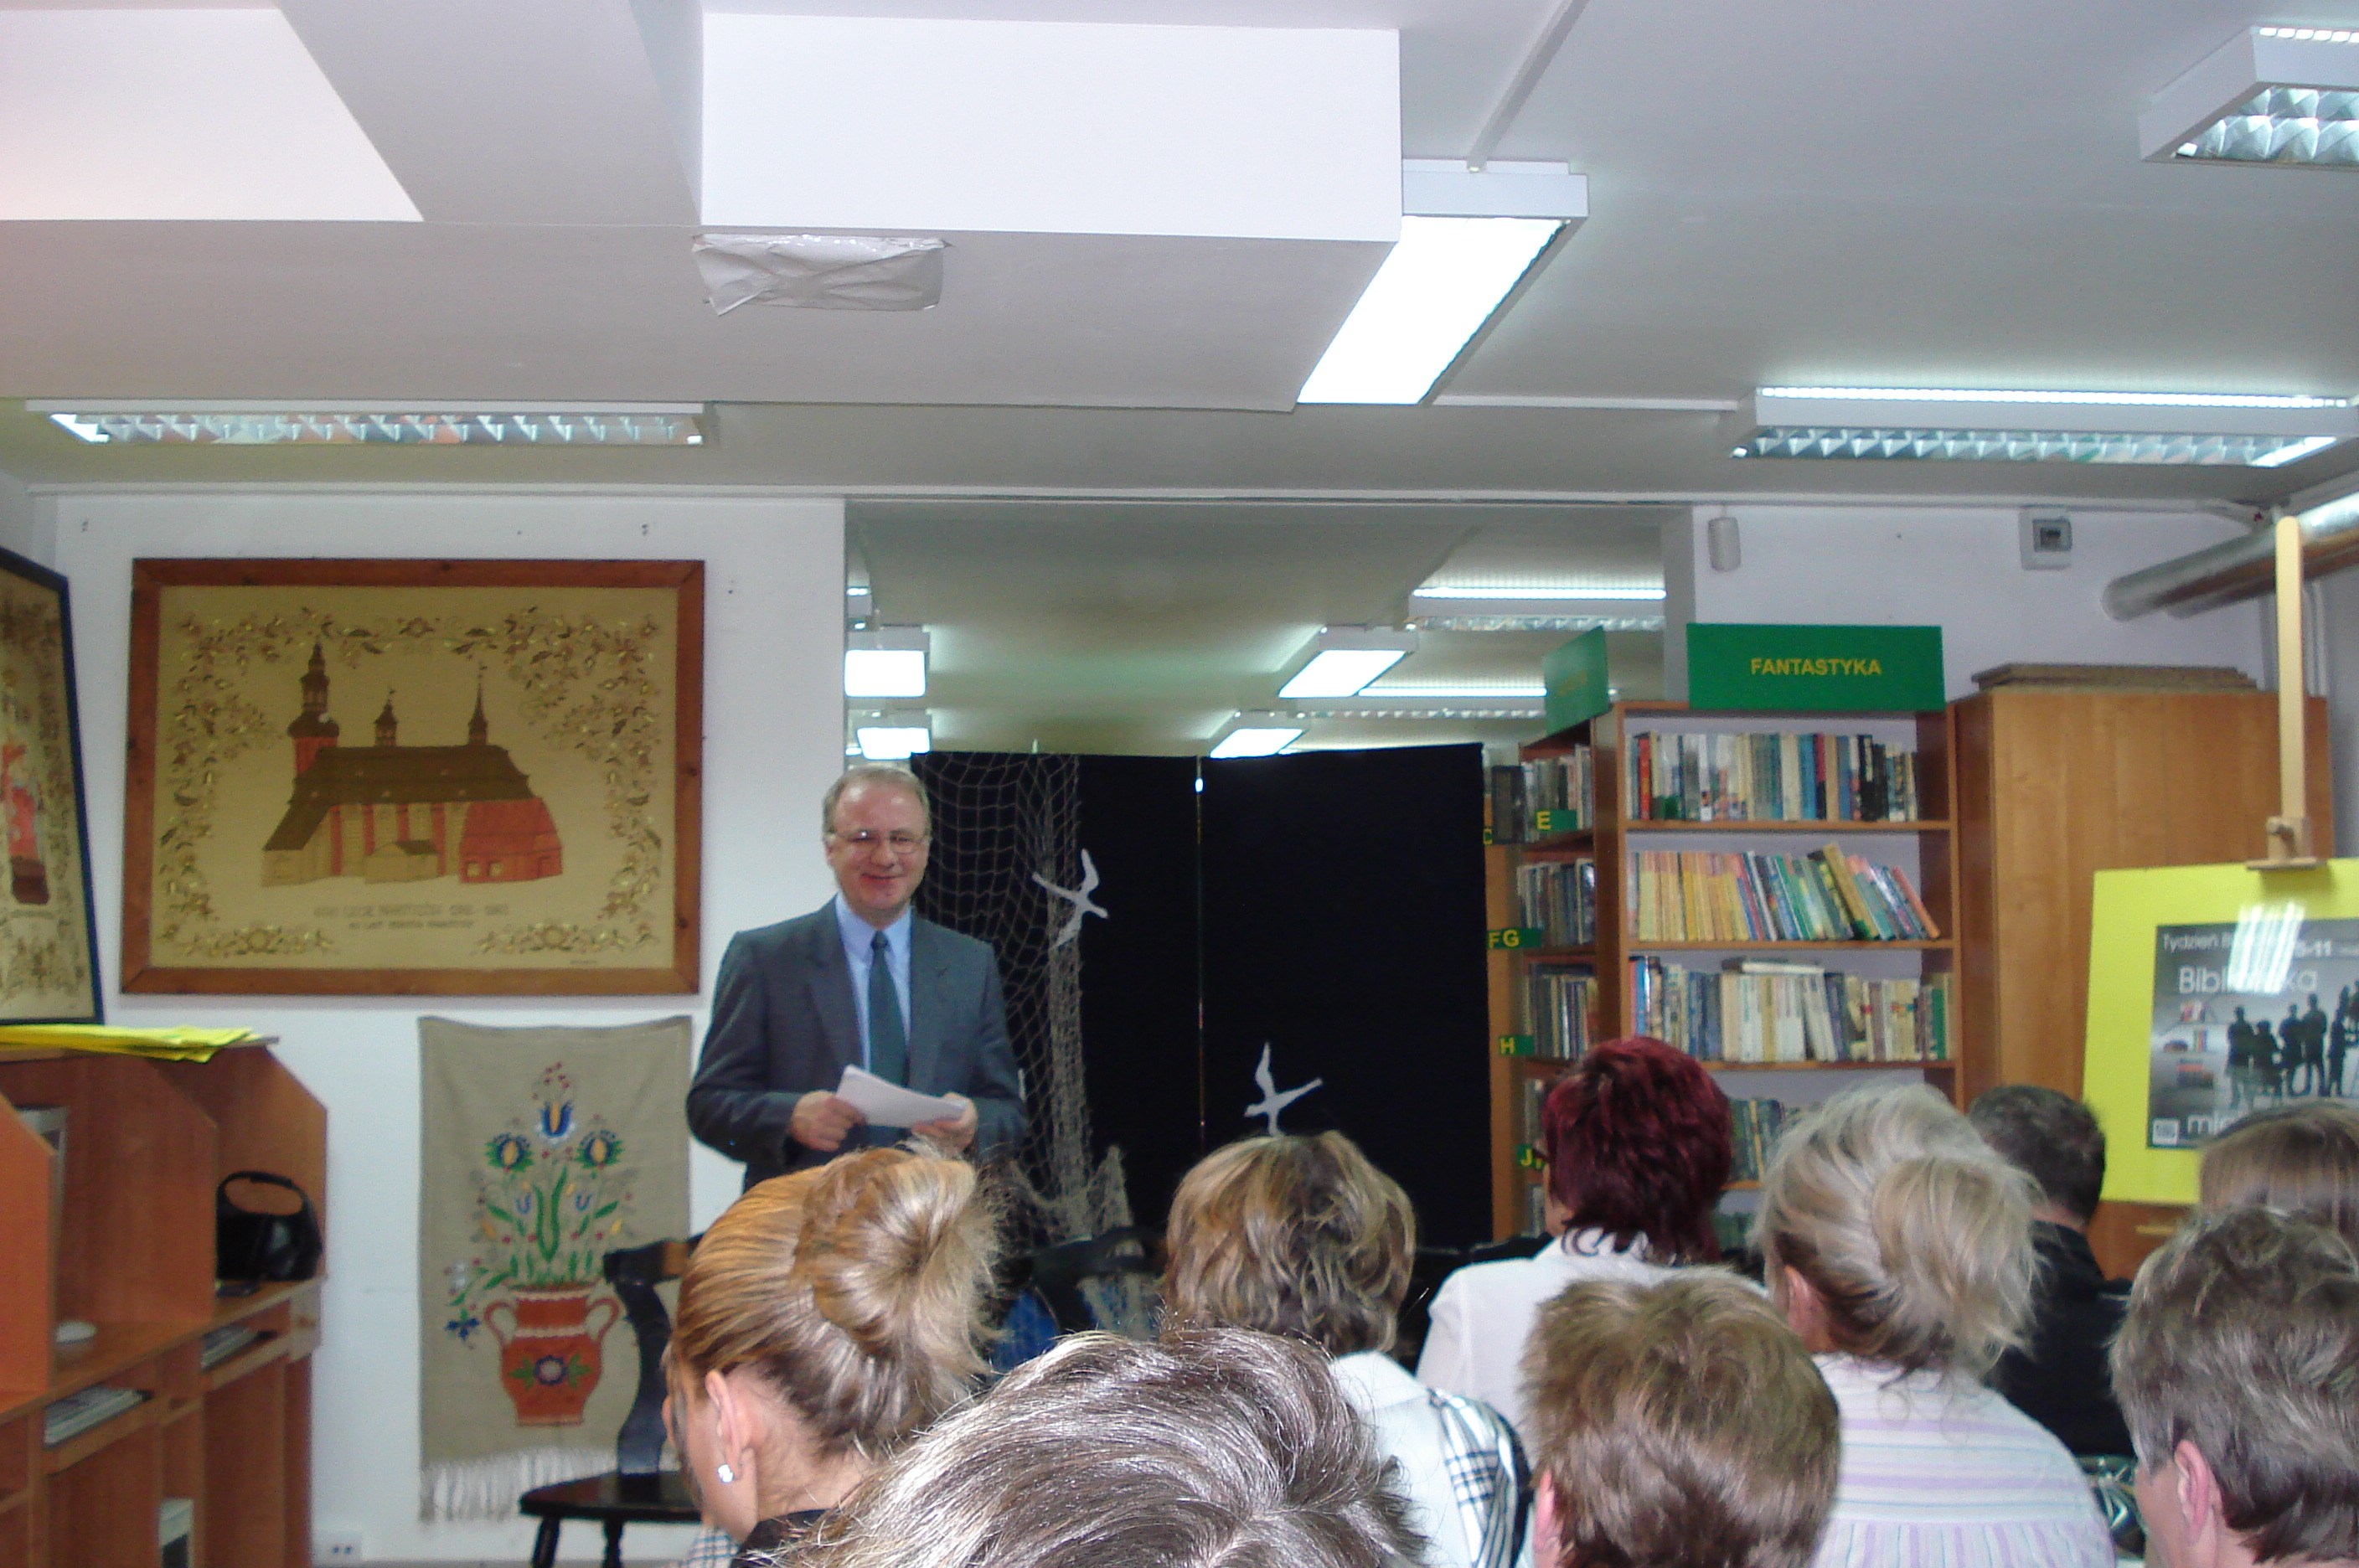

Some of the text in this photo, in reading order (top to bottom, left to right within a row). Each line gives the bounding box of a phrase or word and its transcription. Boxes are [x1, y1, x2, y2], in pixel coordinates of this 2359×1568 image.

[1750, 658, 1882, 676] FANTASTYKA
[1536, 810, 1552, 830] E
[1500, 1037, 1515, 1055] H
